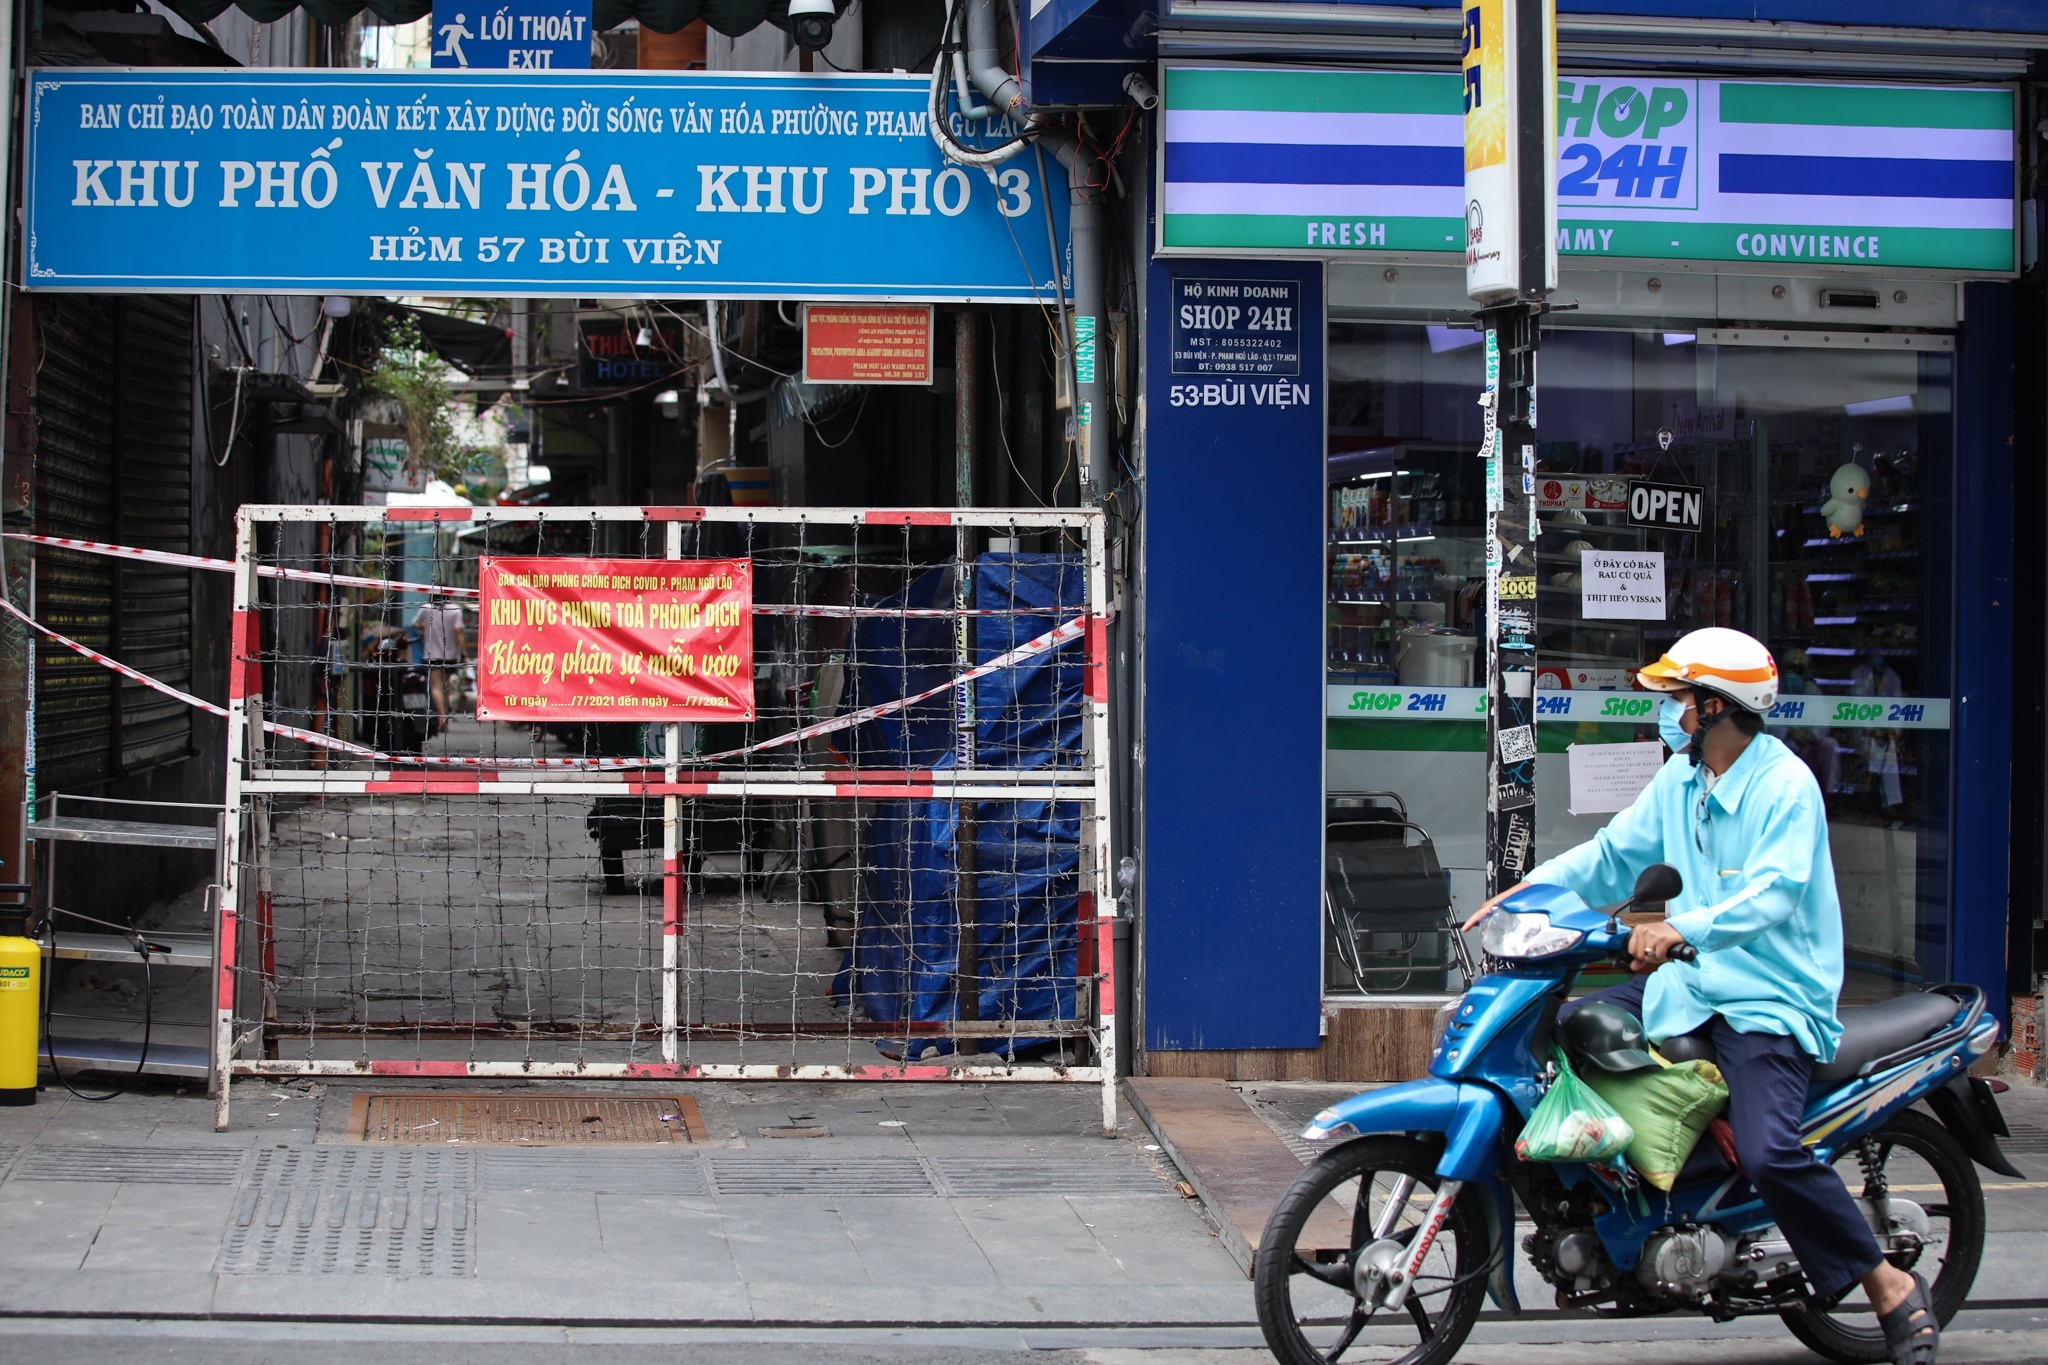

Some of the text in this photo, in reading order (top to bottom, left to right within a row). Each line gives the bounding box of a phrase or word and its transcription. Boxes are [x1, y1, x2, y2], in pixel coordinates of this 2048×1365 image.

[481, 7, 586, 41] LỐI THOÁT
[509, 50, 553, 68] EXIT
[81, 104, 120, 129] BAN
[128, 95, 164, 129] CHỈ
[171, 104, 212, 136] ĐẠO
[221, 98, 276, 130] TOÀN
[282, 99, 325, 130] DÂN
[332, 98, 389, 130] ĐOÀN
[396, 94, 440, 131] KẾT
[445, 99, 490, 131] XÂY
[496, 101, 554, 137] DỰNG
[562, 101, 599, 133] ĐỜI
[606, 96, 662, 134] SỐNG
[670, 103, 713, 134] VĂN
[720, 102, 765, 134] HÓA
[772, 102, 858, 136] PHƯỜNG
[865, 109, 927, 142] PHẠM
[72, 159, 199, 208] KHU
[219, 137, 343, 209] PHỐ
[361, 148, 485, 210] VĂN
[506, 149, 637, 212] HÓA
[656, 187, 675, 198] -
[696, 166, 824, 215] KHU
[998, 169, 1032, 218] 3
[1558, 143, 1687, 199] 24H
[369, 227, 722, 270] HẺM 57 BÙI VIỆN
[1307, 223, 1386, 245] FRESH
[1737, 233, 1879, 258] CONVIENCE
[1184, 283, 1288, 298] HỘ KINH DOANH
[1181, 305, 1292, 331] SHOP 24H
[1183, 350, 1193, 359] BÙI
[1194, 351, 1206, 360] VIỆN
[1218, 352, 1233, 361] PHẠM
[1248, 352, 1258, 360] LÃO
[1222, 338, 1281, 347] 8055322402
[1250, 378, 1310, 409] VIỆN
[1631, 487, 1699, 525] OPEN
[1598, 571, 1617, 579] RAU
[1633, 569, 1652, 580] QUẢ
[1603, 558, 1621, 568] ĐÂY
[1624, 558, 1636, 569] CÓ
[1638, 558, 1656, 569] BÁN
[498, 571, 732, 593] BAN CHỈ ĐẠO PHÒNG CHỐNG DỊCH COVID P. PHẠM NGŨ LÃO
[491, 595, 740, 633] KHU VỰC PHONG TOẢ PHÒNG DỊCH
[1586, 594, 1608, 604] THỊT
[1610, 594, 1628, 603] HEO
[488, 638, 742, 685] Không phận sự miễn vào
[504, 695, 517, 707] Từ
[521, 696, 548, 708] ngày
[618, 695, 638, 707] đến
[641, 696, 668, 708] ngày
[1348, 692, 1924, 721] SHOP 24H 24H SHOP 24H SHOP 24H
[1409, 1214, 1447, 1277] HONDA
